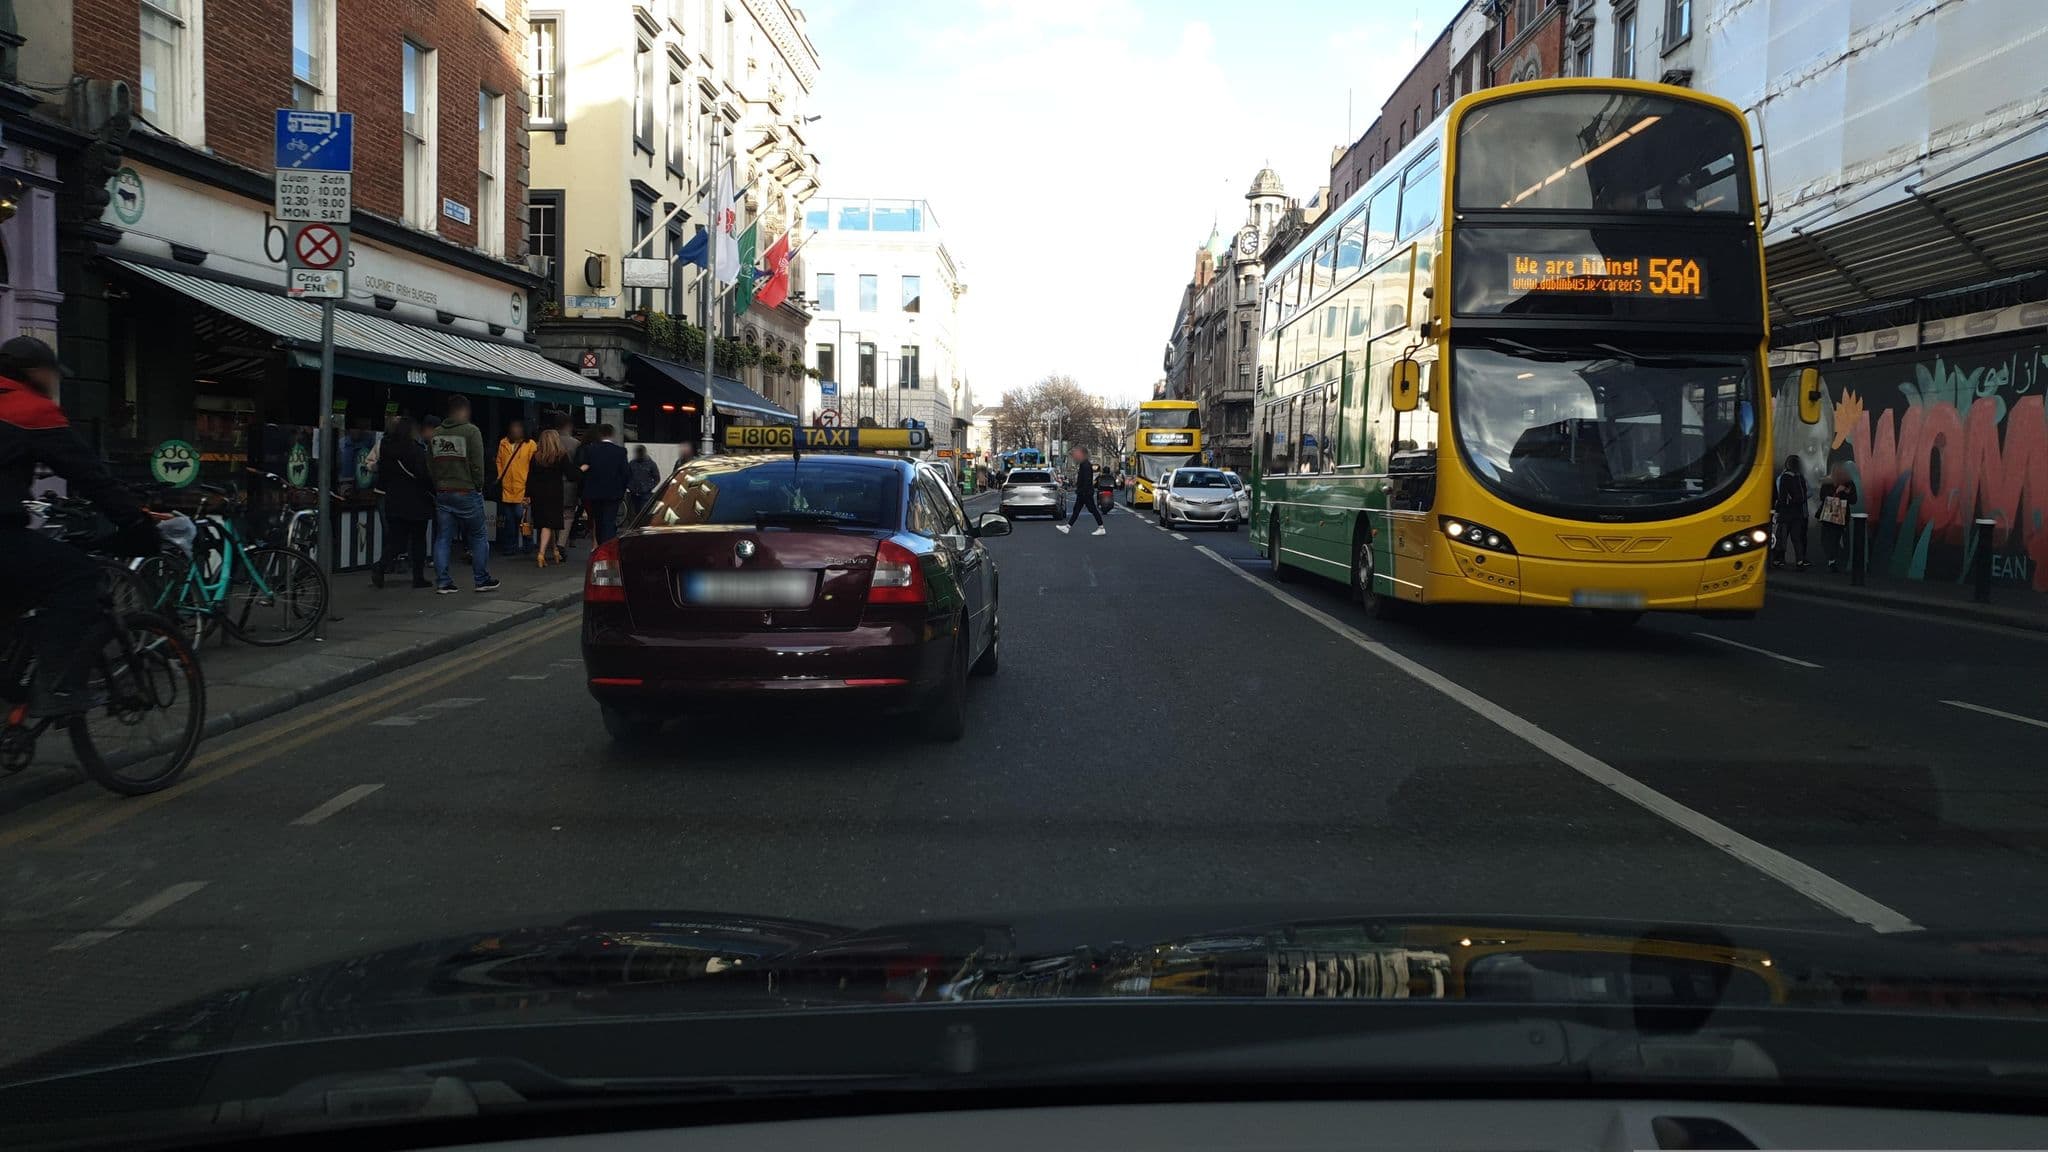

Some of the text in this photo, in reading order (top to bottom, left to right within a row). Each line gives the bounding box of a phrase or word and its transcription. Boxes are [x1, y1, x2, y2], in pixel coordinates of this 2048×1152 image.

[281, 196, 345, 208] 12.30 19.00
[283, 208, 343, 219] MON SAT
[1515, 257, 1639, 276] We are hiring!
[1648, 258, 1700, 295] 56A
[365, 275, 394, 292] GOURMET
[411, 288, 437, 304] BURGERS
[804, 429, 850, 446] TAXI
[910, 432, 922, 446] D
